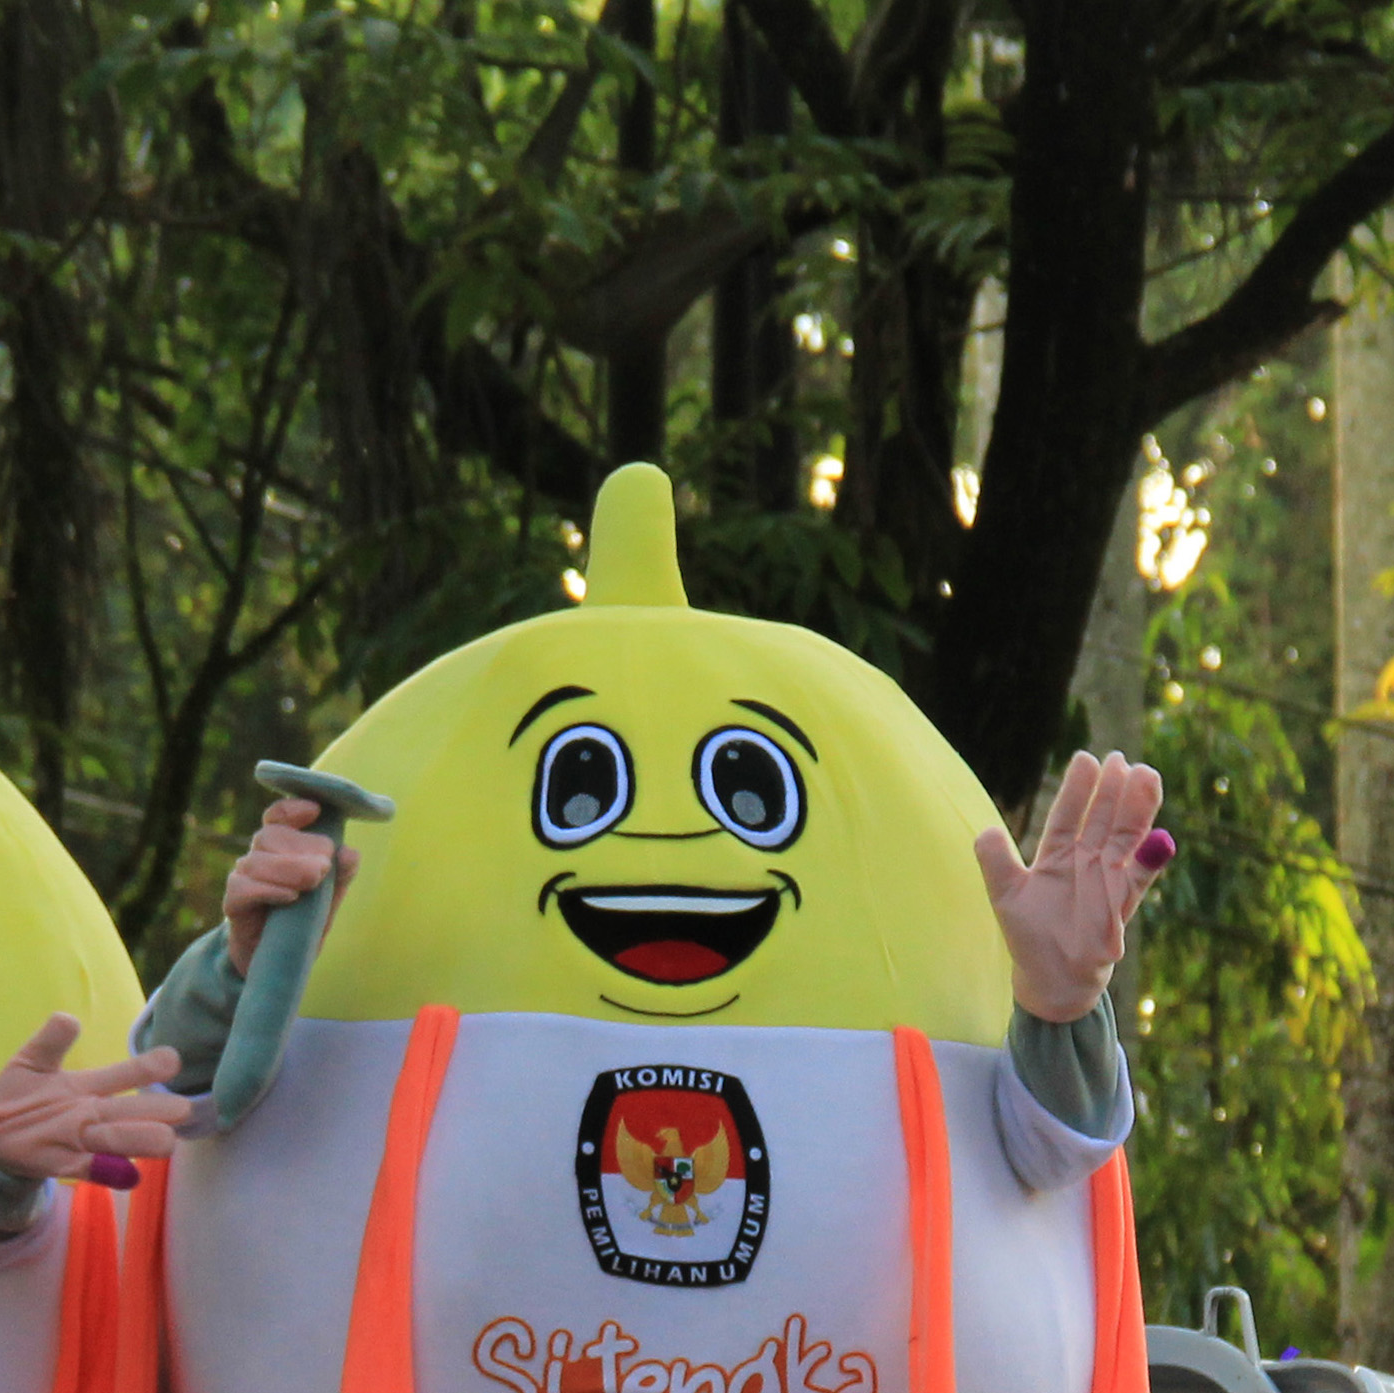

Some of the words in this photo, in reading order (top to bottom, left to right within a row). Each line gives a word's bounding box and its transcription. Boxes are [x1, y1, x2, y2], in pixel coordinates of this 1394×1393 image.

[613, 1067, 726, 1093] KOMISI
[582, 1187, 707, 1282] PEMILIHAN
[719, 1192, 766, 1281] UMUM
